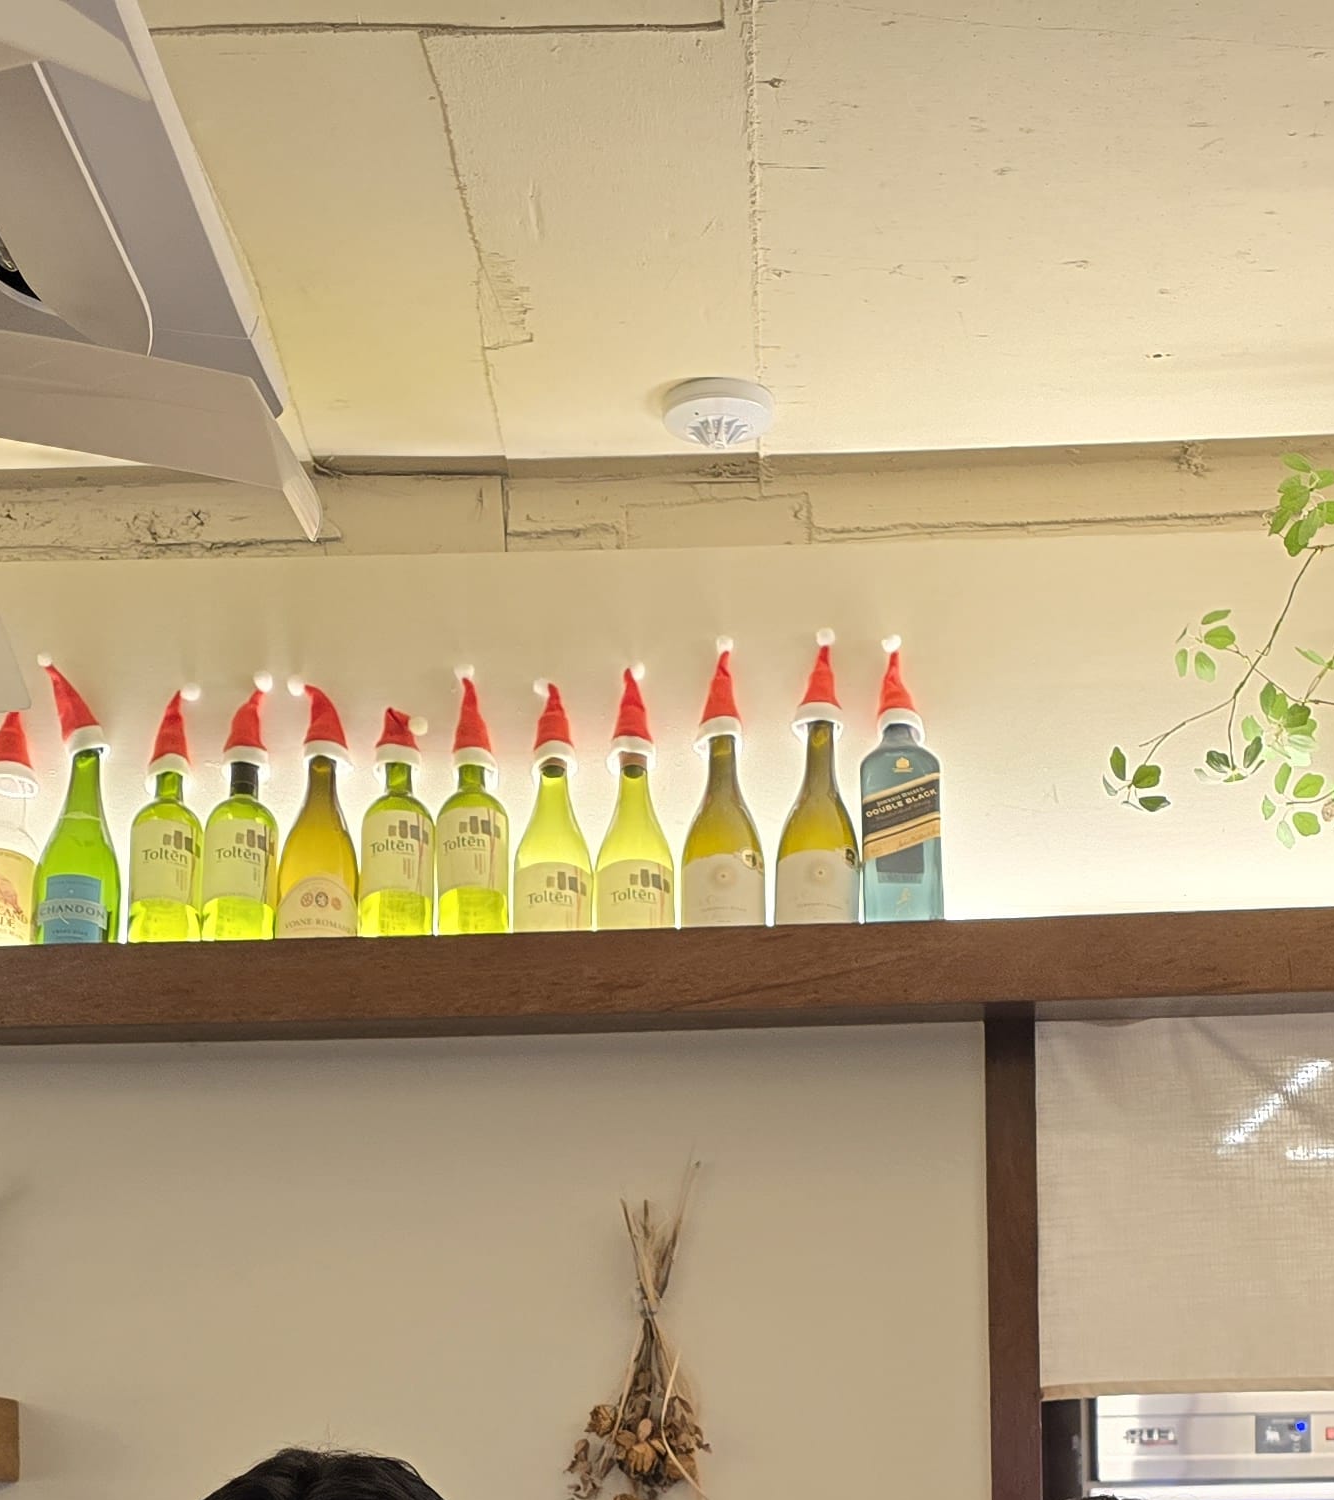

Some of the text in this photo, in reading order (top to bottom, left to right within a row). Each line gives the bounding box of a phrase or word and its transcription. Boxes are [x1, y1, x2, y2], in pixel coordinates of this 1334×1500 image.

[866, 801, 904, 818] DOUBLE
[905, 789, 938, 804] BLACK
[39, 904, 105, 920] CHANDON
